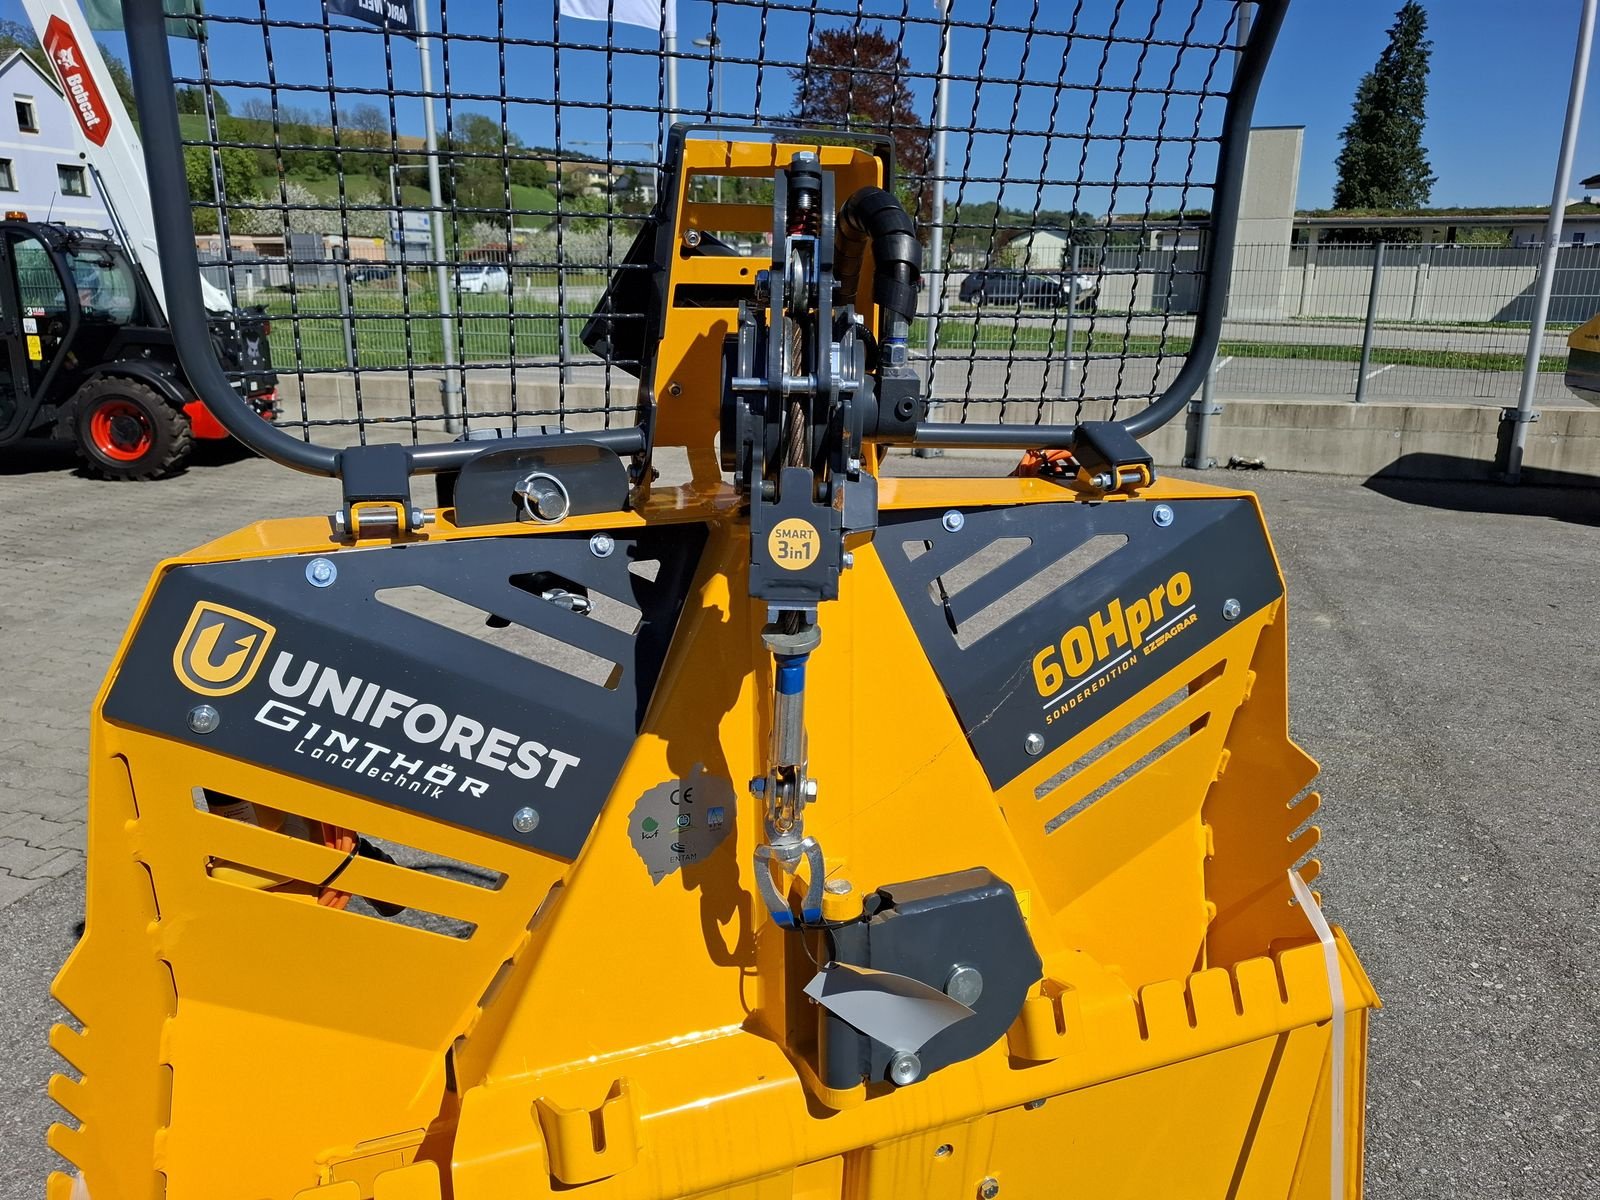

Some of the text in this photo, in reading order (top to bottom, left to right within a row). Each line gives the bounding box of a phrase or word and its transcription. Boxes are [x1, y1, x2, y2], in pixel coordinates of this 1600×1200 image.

[66, 73, 100, 129] Bobcat
[775, 528, 814, 539] SMART
[777, 540, 811, 560] 3in1
[1032, 571, 1192, 698] 60Hpro
[1045, 654, 1138, 725] SONDEREDITION
[268, 650, 581, 789] UNIFOREST
[670, 853, 697, 863] ENTAM
